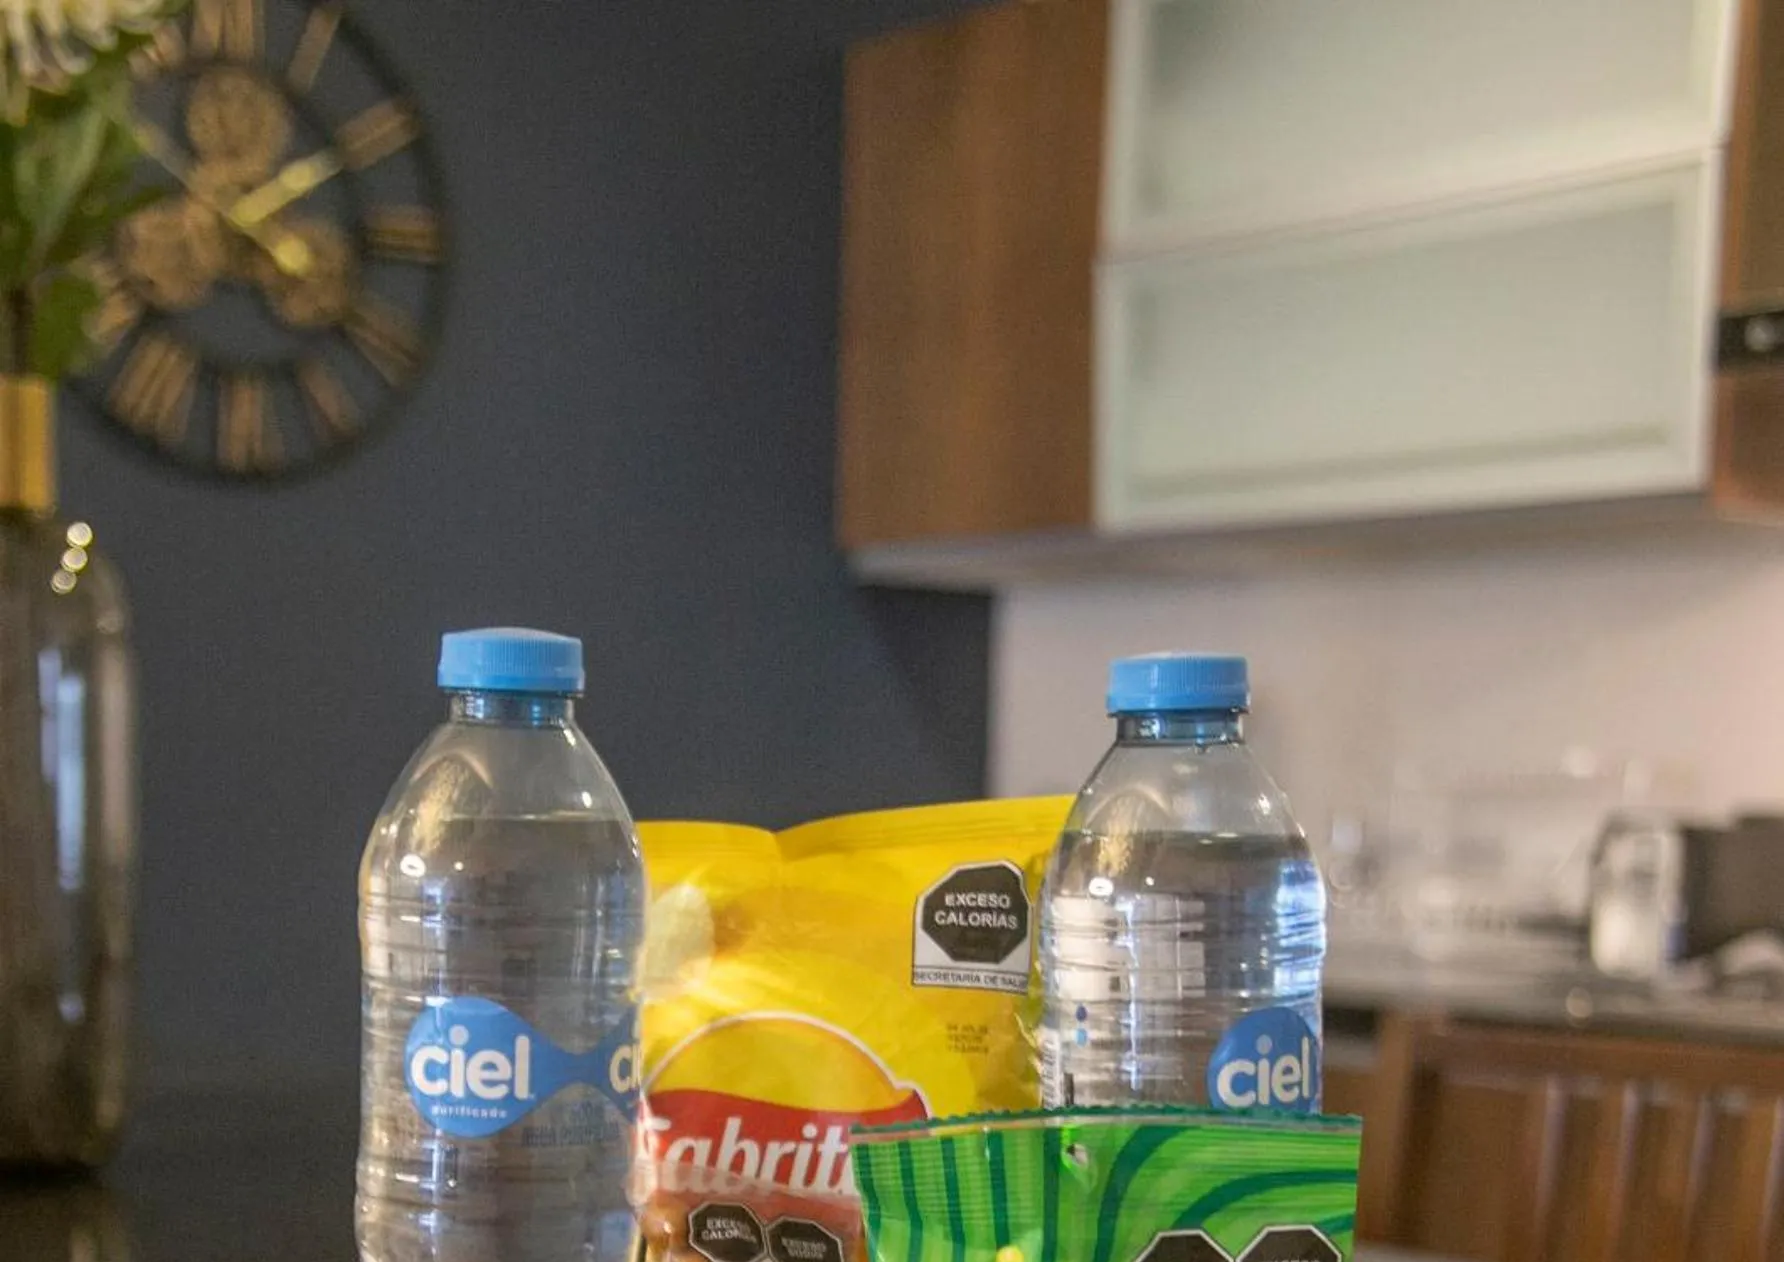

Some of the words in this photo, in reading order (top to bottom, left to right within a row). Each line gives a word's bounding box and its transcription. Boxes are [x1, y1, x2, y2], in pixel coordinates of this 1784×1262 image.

[934, 910, 1018, 930] CALORÍAS
[945, 893, 1011, 909] EXCESO
[1001, 975, 1028, 987] SALU
[410, 1025, 531, 1100] ciel
[1217, 1034, 1310, 1107] ciel
[645, 1116, 860, 1196] abrit
